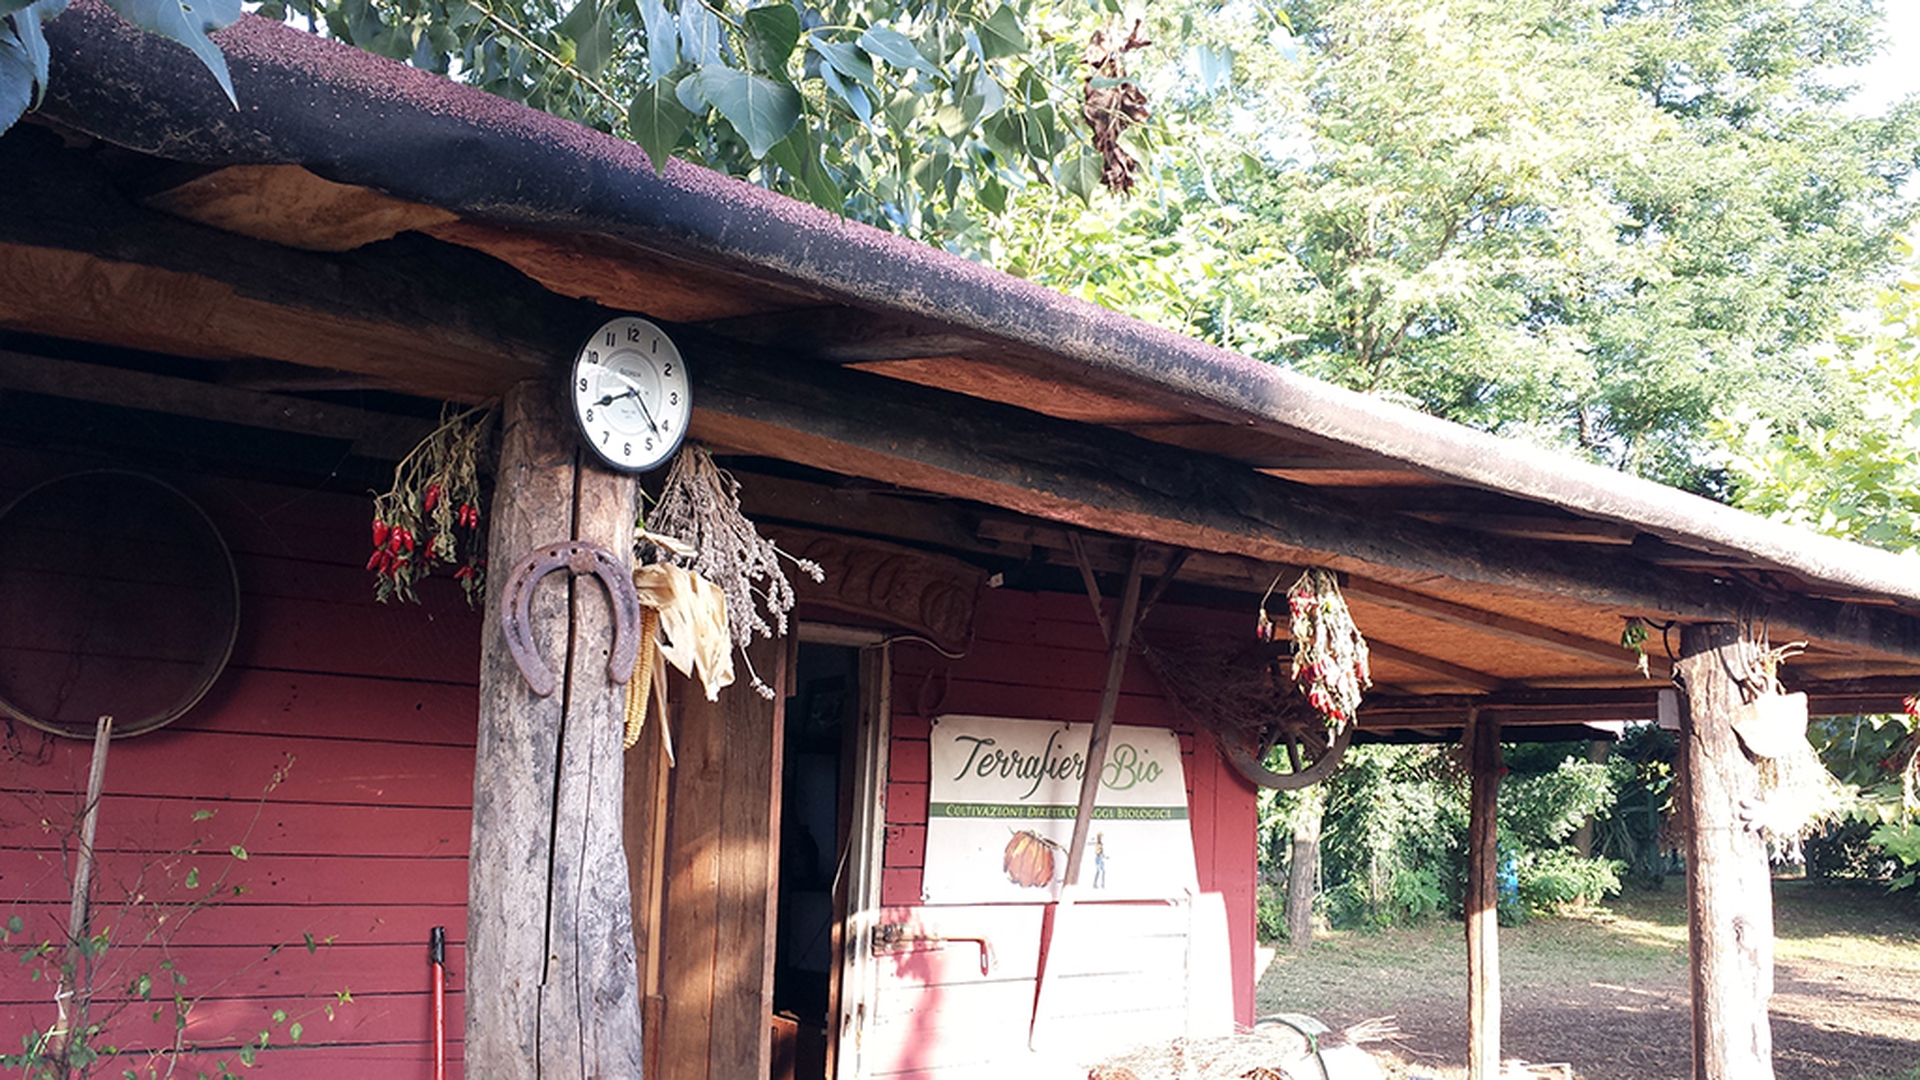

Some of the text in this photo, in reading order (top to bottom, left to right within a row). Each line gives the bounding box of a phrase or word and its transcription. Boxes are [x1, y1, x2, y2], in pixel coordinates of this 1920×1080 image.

[606, 332, 616, 347] 11
[627, 328, 640, 343] 12
[652, 340, 657, 354] 1
[587, 351, 599, 364] 10
[663, 363, 672, 377] 2
[579, 378, 588, 392] 9
[670, 392, 678, 406] 3
[586, 408, 594, 423] 8
[661, 419, 669, 432] 4
[602, 431, 610, 445] 7
[645, 437, 653, 451] 5
[623, 442, 631, 456] 6
[954, 730, 1163, 800] Terrafier Bio
